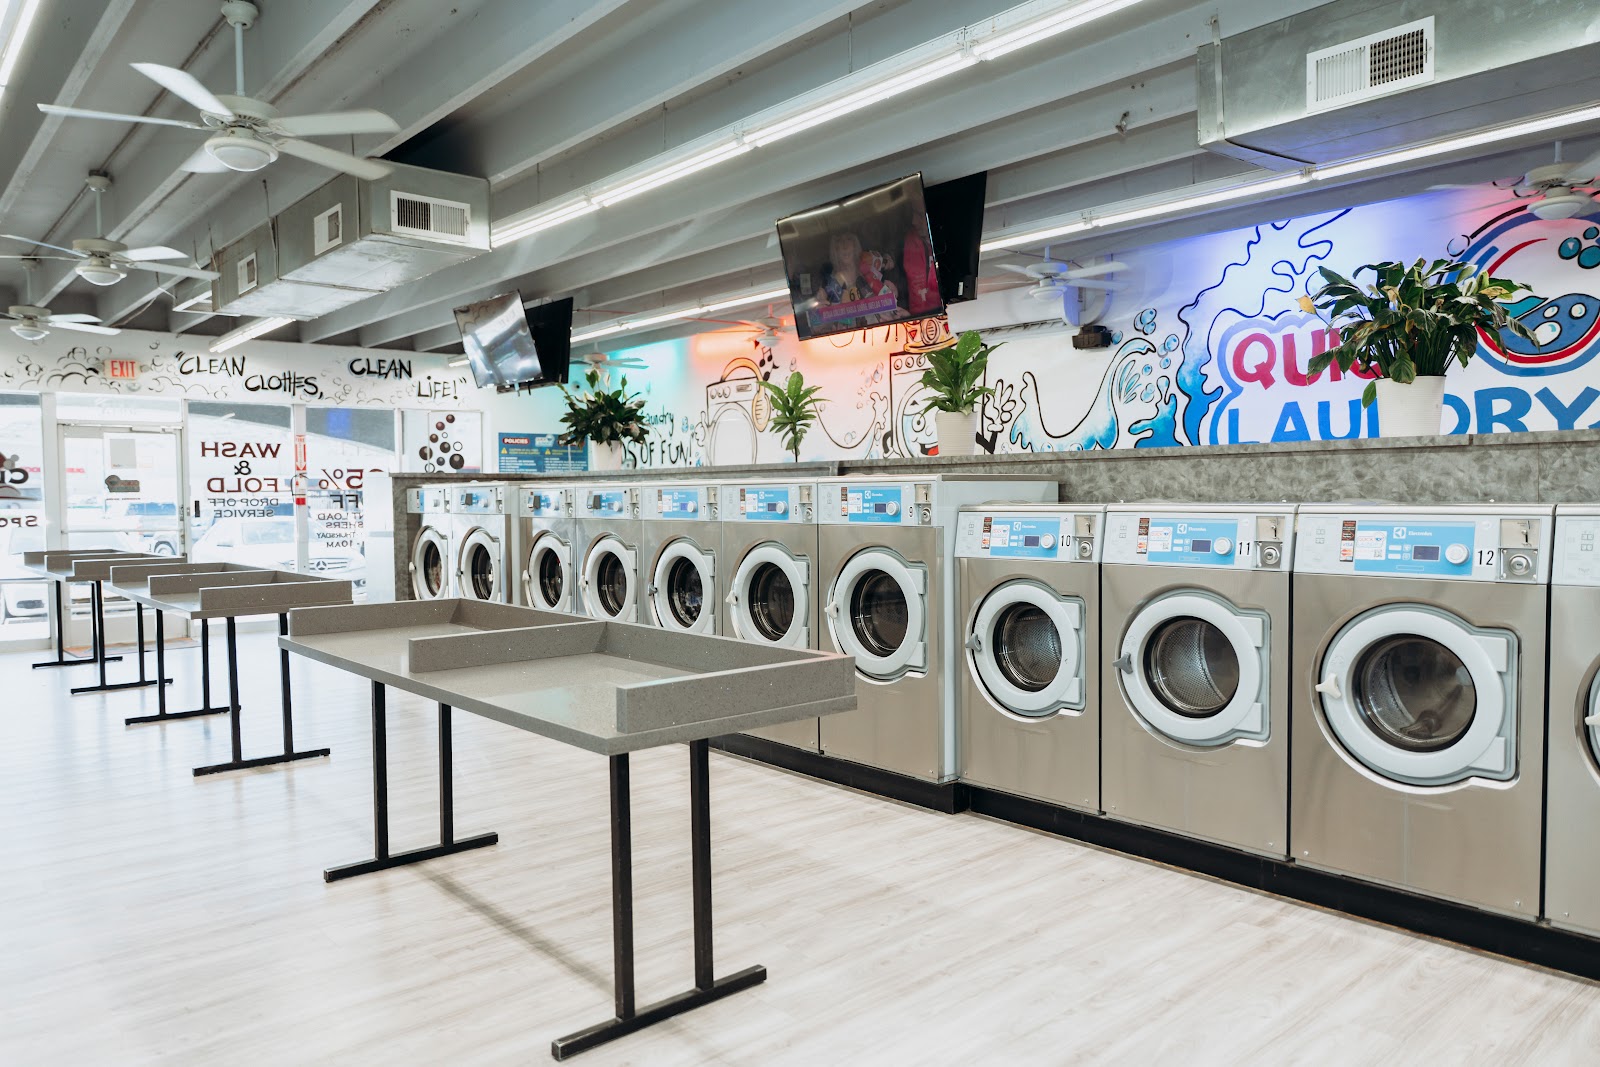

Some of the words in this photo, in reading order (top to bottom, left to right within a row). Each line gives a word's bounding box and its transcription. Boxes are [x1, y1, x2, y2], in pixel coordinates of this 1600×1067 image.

[111, 360, 136, 378] EXIT
[349, 358, 412, 379] CLEAN
[1228, 386, 1600, 443] LAUDRY
[640, 439, 655, 467] OF
[1060, 534, 1072, 547] 10
[1238, 541, 1251, 556] 11
[1476, 549, 1495, 566] 12
